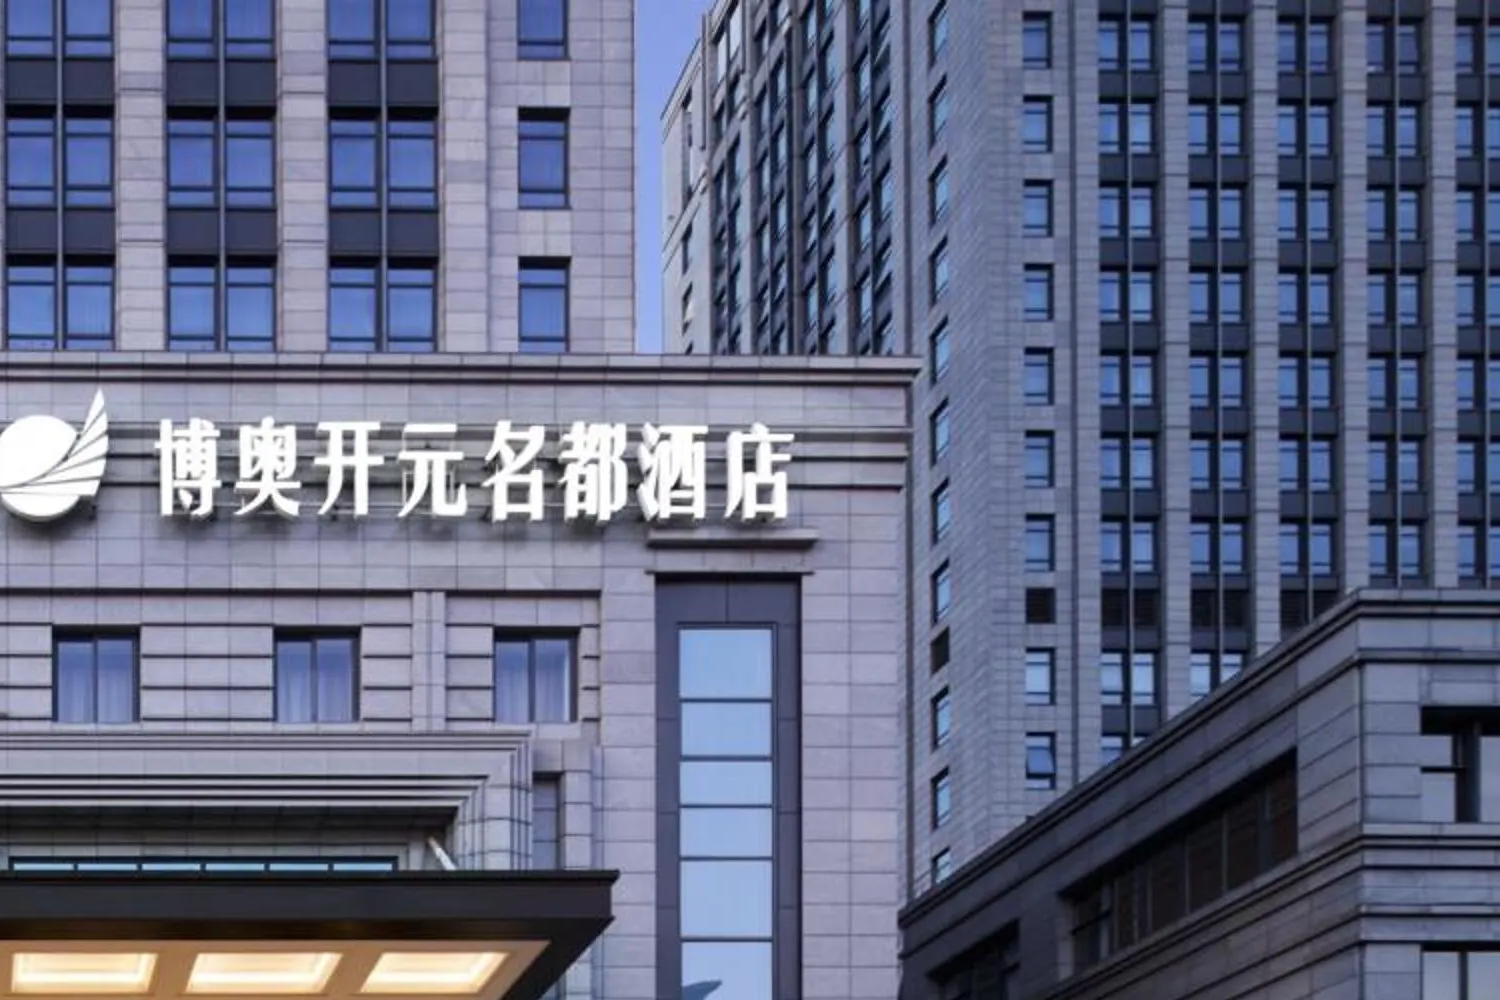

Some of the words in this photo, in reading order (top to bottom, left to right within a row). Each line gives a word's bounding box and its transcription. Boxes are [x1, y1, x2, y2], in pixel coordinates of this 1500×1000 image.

[155, 417, 794, 522] 博奥开元名都酒店
